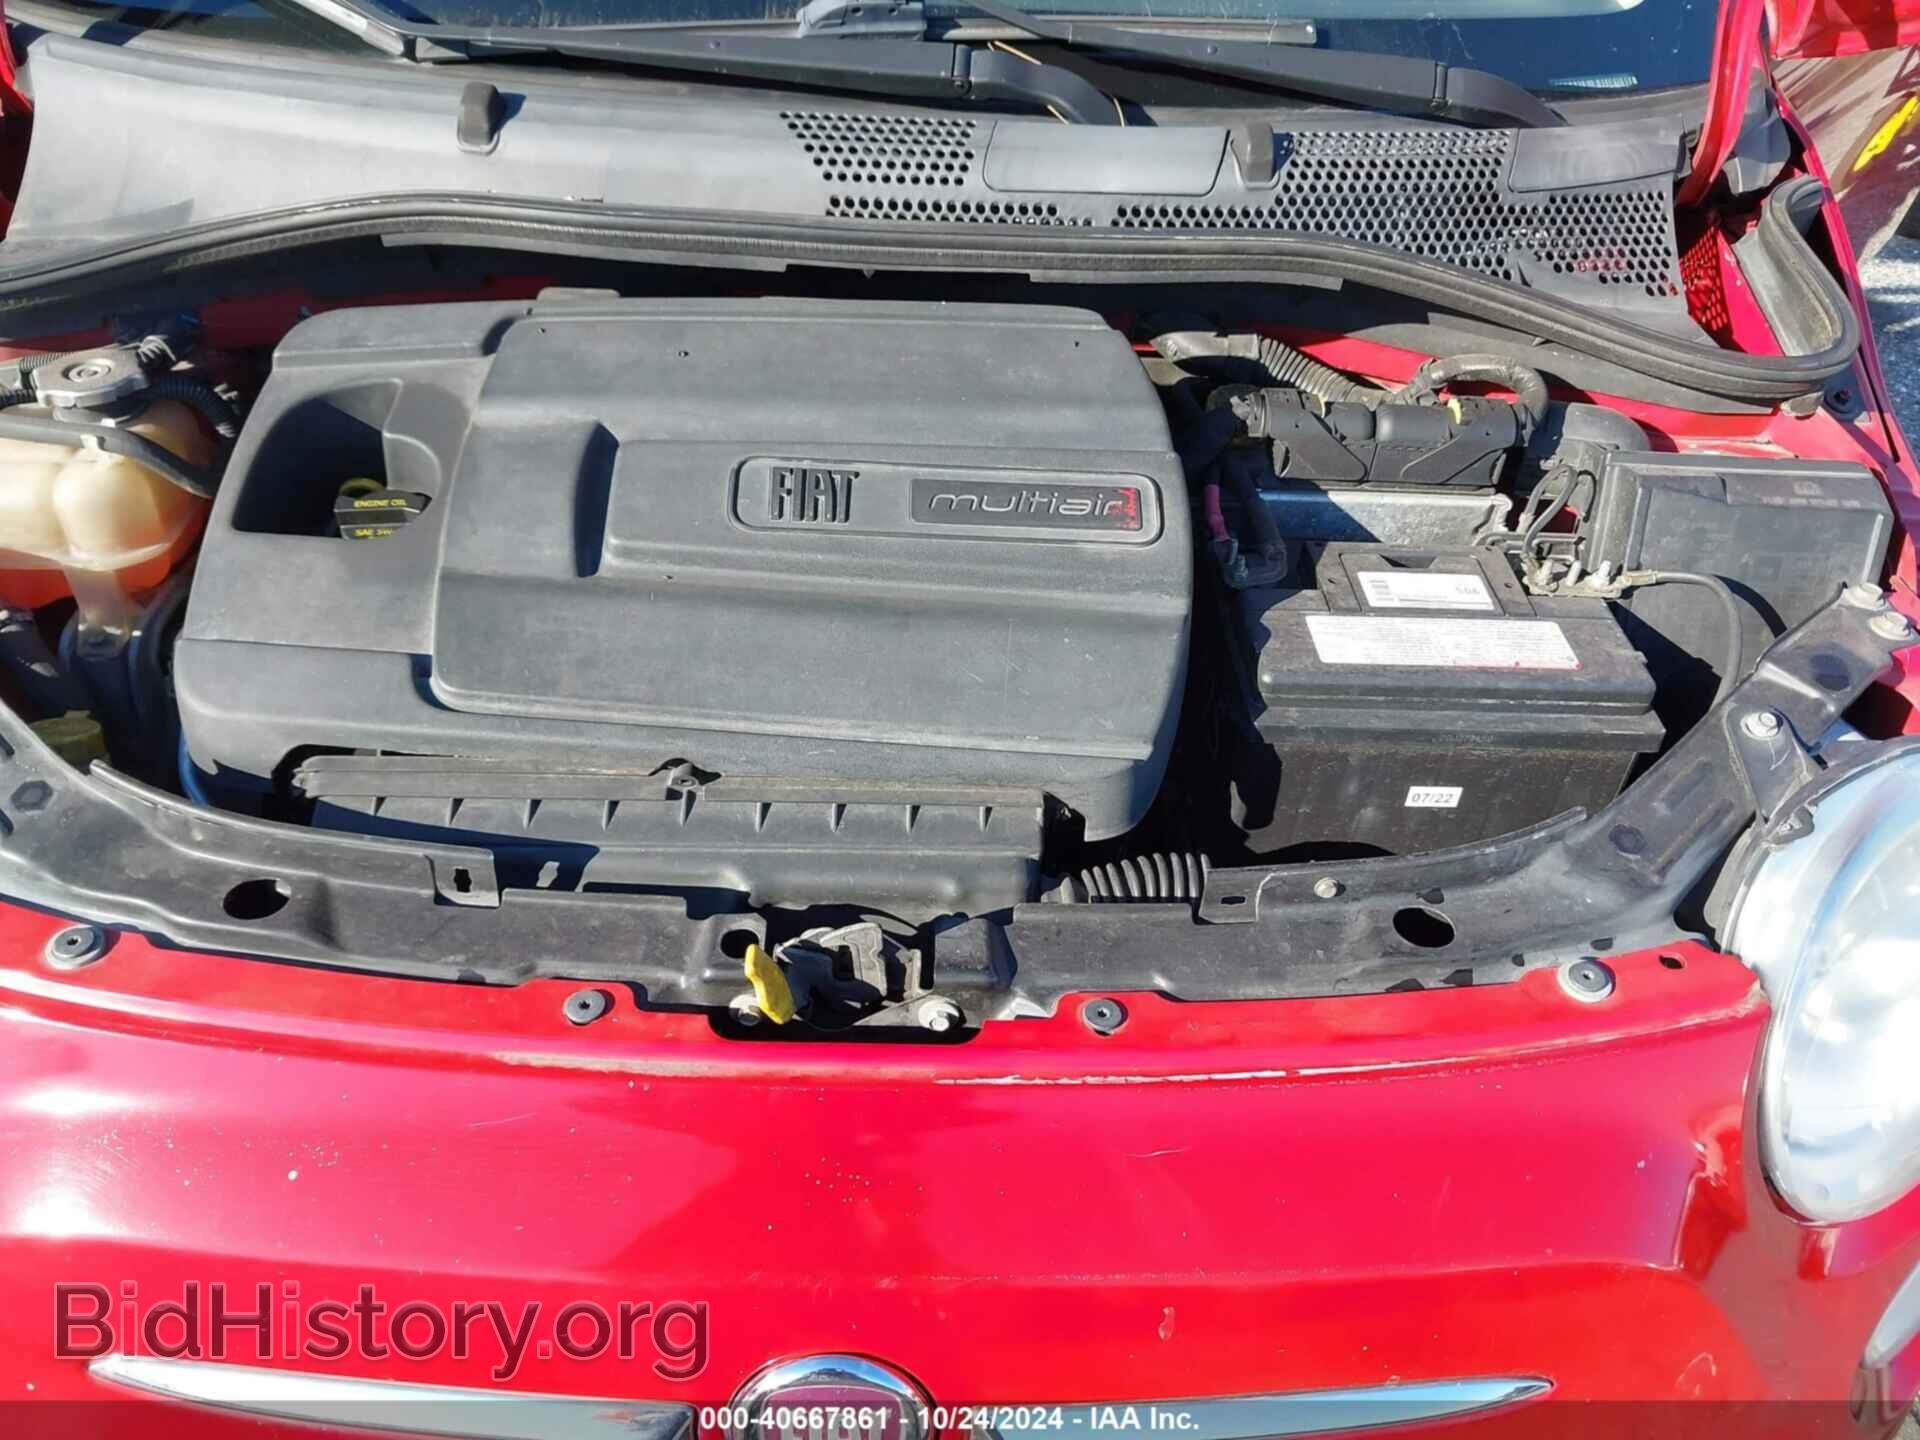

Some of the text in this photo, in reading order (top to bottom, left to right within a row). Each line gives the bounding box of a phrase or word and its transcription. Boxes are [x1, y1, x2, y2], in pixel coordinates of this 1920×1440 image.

[769, 466, 860, 523] FIAT
[929, 490, 1123, 516] multiair
[1411, 792, 1455, 804] 07/22
